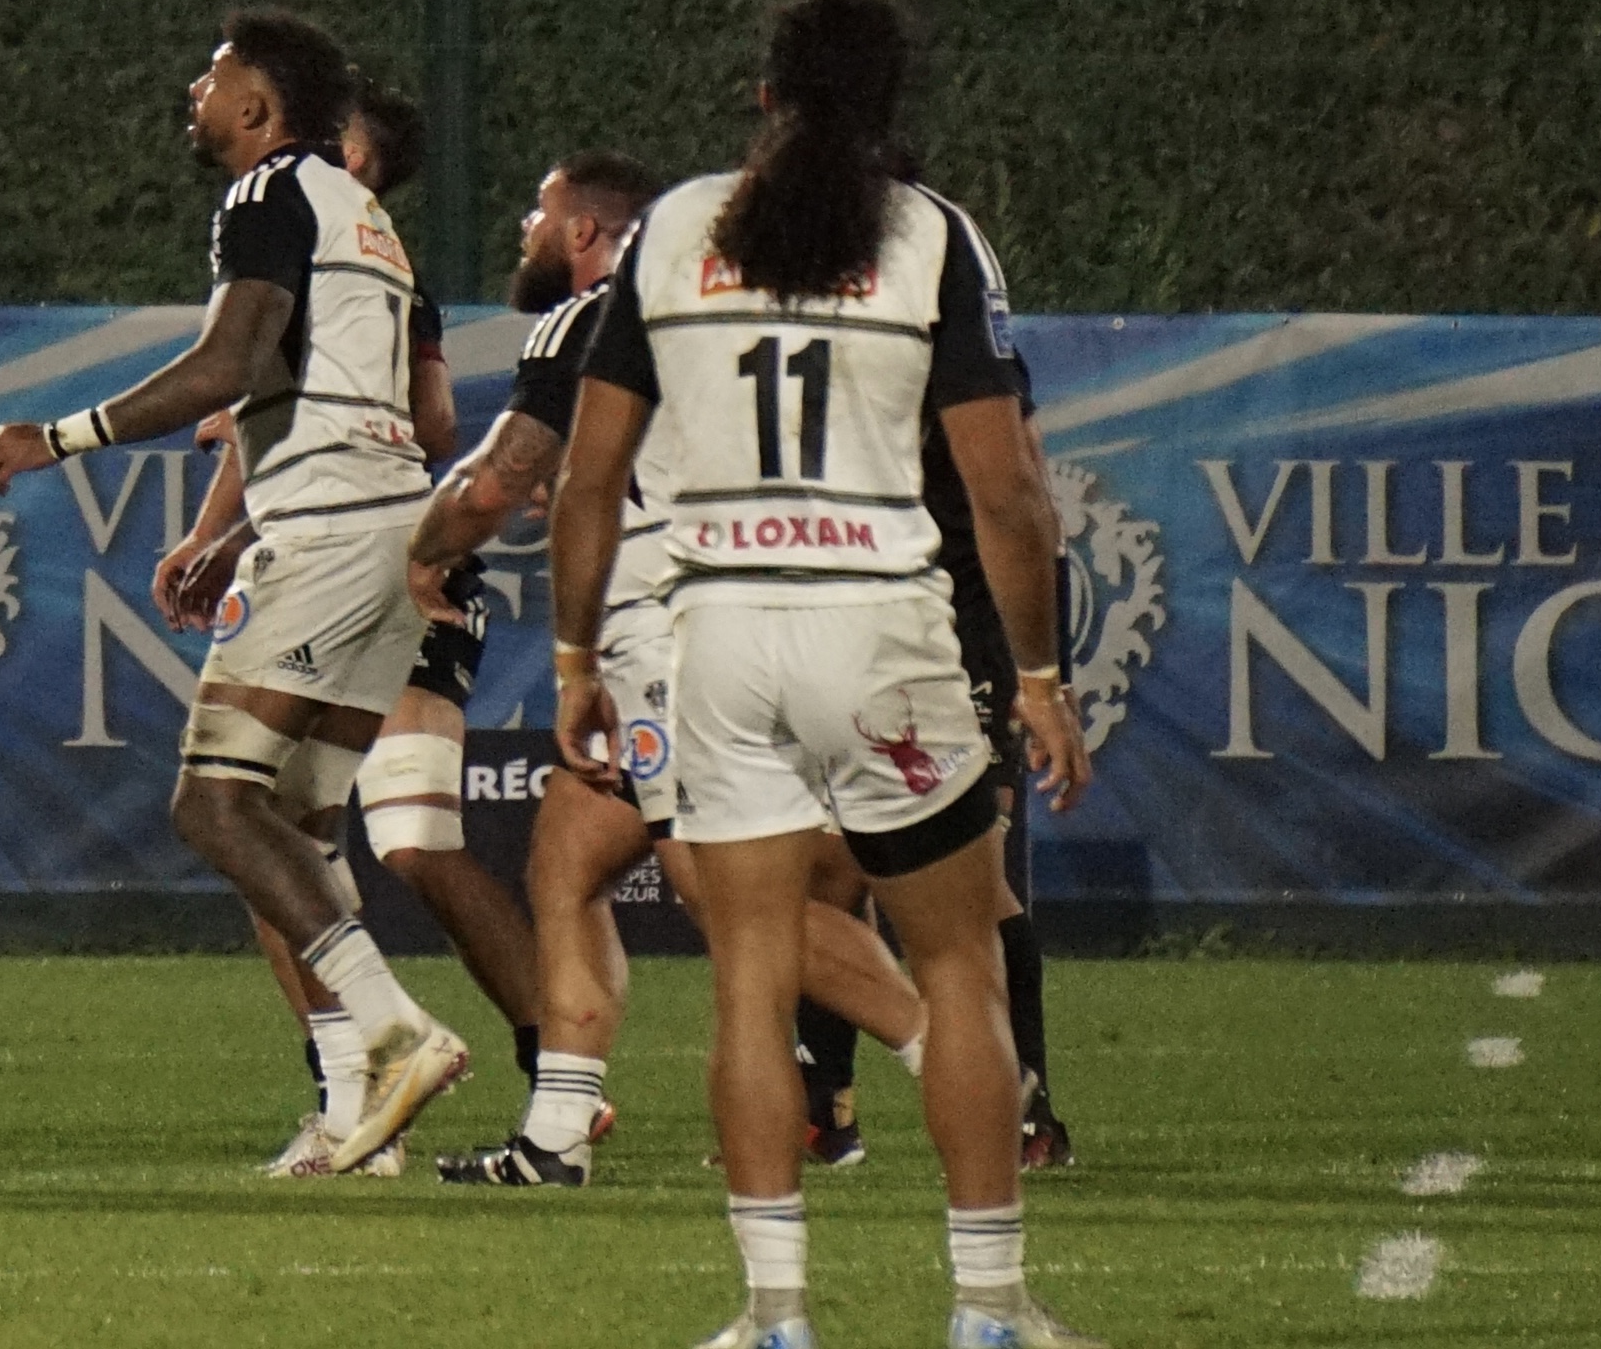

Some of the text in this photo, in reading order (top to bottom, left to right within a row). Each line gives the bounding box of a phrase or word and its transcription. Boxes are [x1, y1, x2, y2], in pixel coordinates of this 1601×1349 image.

[738, 336, 831, 480] 11
[732, 517, 879, 553] LOXAM
[1195, 459, 1579, 566] VILLE
